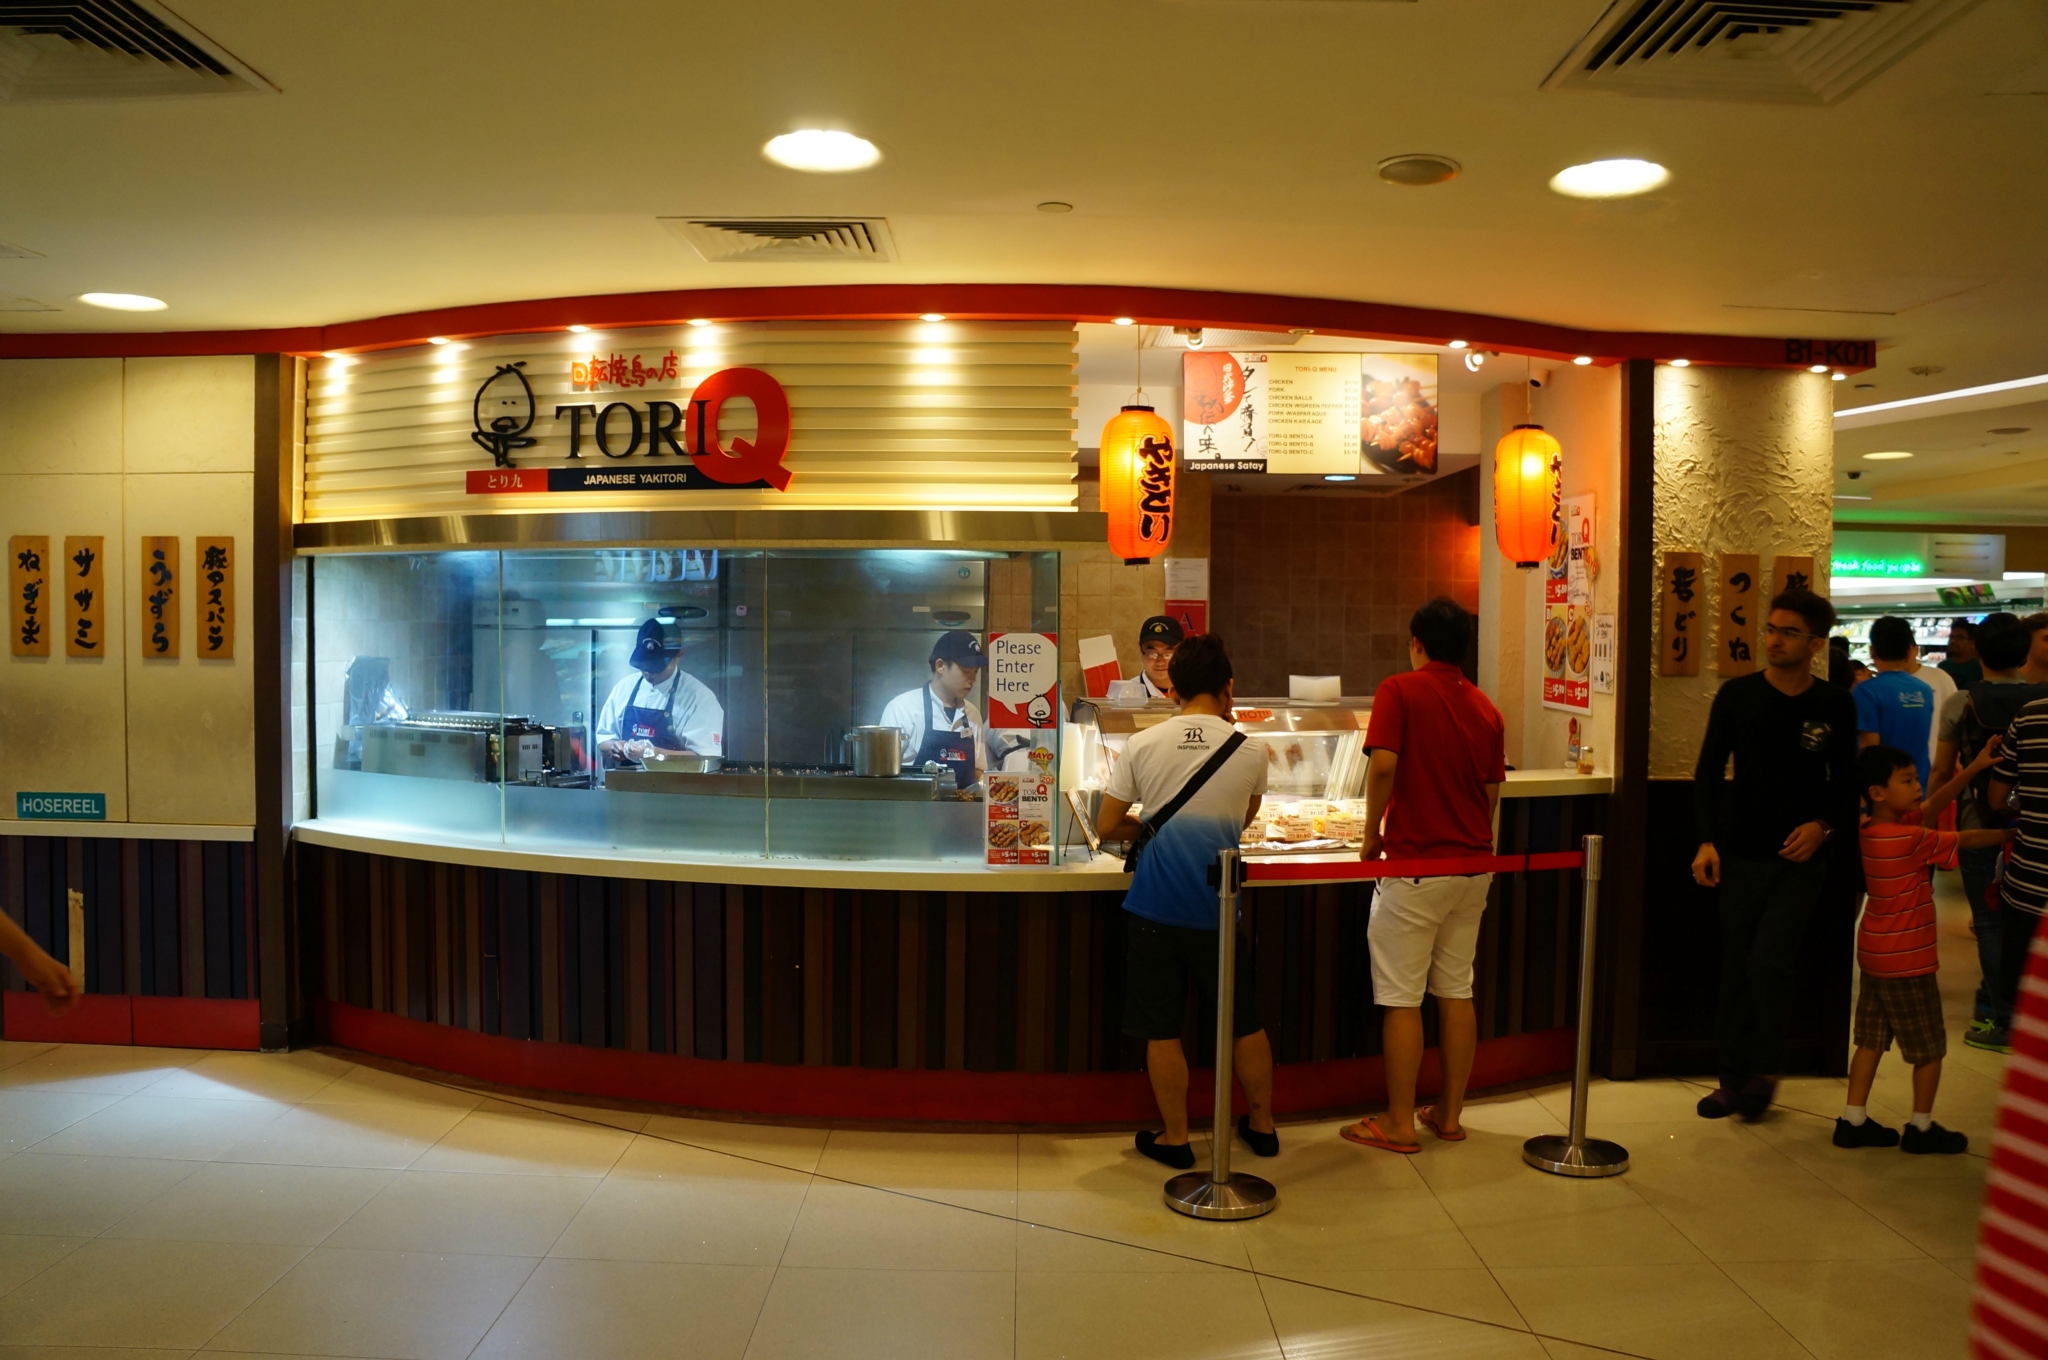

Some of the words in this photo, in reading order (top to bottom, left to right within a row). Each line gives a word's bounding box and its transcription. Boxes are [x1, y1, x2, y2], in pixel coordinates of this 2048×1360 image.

[1785, 338, 1868, 365] B1-K01
[554, 400, 713, 459] TORI
[685, 367, 794, 493] Q
[1190, 462, 1235, 472] Japanese
[1237, 461, 1264, 472] Satay
[487, 474, 523, 489] とり九
[583, 474, 636, 485] JAPANESE
[640, 473, 687, 484] YAKITORI
[1139, 436, 1173, 542] やきとり
[1832, 560, 1860, 571] fresh
[1862, 559, 1885, 572] food
[17, 548, 43, 645] ねぎま
[72, 547, 98, 649] ササミ
[149, 549, 174, 653] うずら
[1180, 612, 1195, 631] A
[1729, 571, 1752, 662] つくね
[996, 640, 1042, 654] Please
[996, 659, 1034, 673] Enter
[996, 678, 1030, 692] Here
[1028, 751, 1054, 760] MAYO
[22, 798, 100, 814] HOSEREEL
